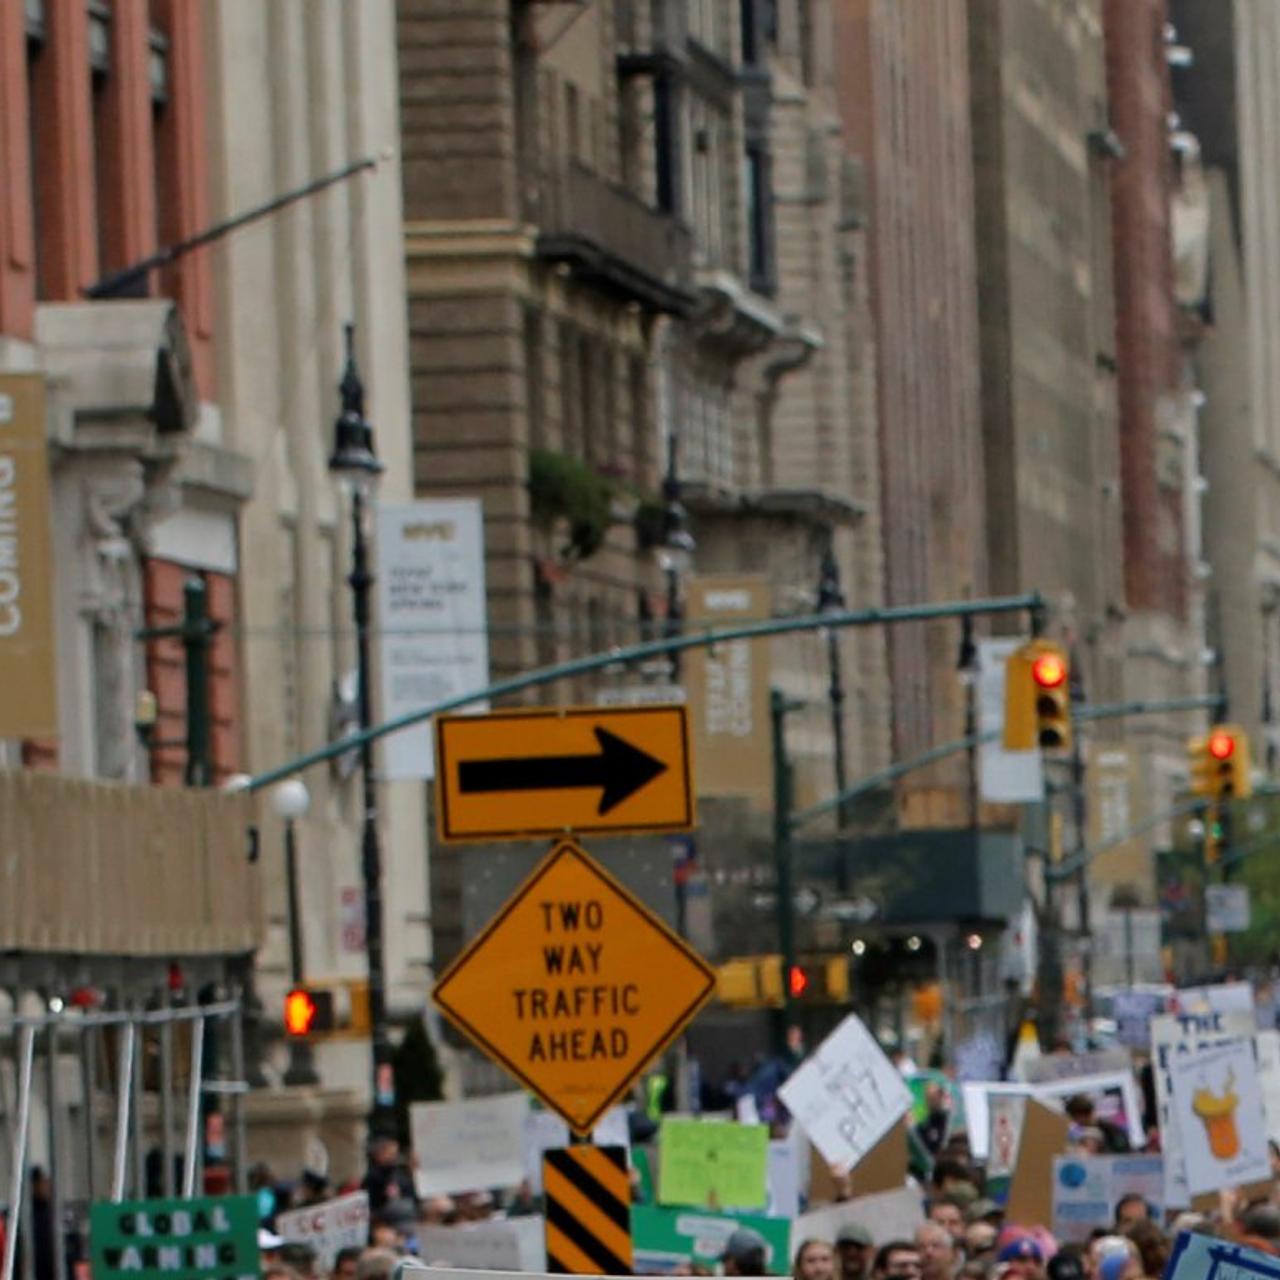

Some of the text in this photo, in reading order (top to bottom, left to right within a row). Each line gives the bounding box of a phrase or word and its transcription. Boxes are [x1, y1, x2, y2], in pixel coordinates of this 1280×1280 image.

[541, 902, 604, 932] TWO
[542, 945, 603, 975] WAY
[513, 985, 640, 1019] TRAFFIC
[528, 1027, 630, 1062] AHEAD
[118, 1206, 229, 1237] GLOBAL
